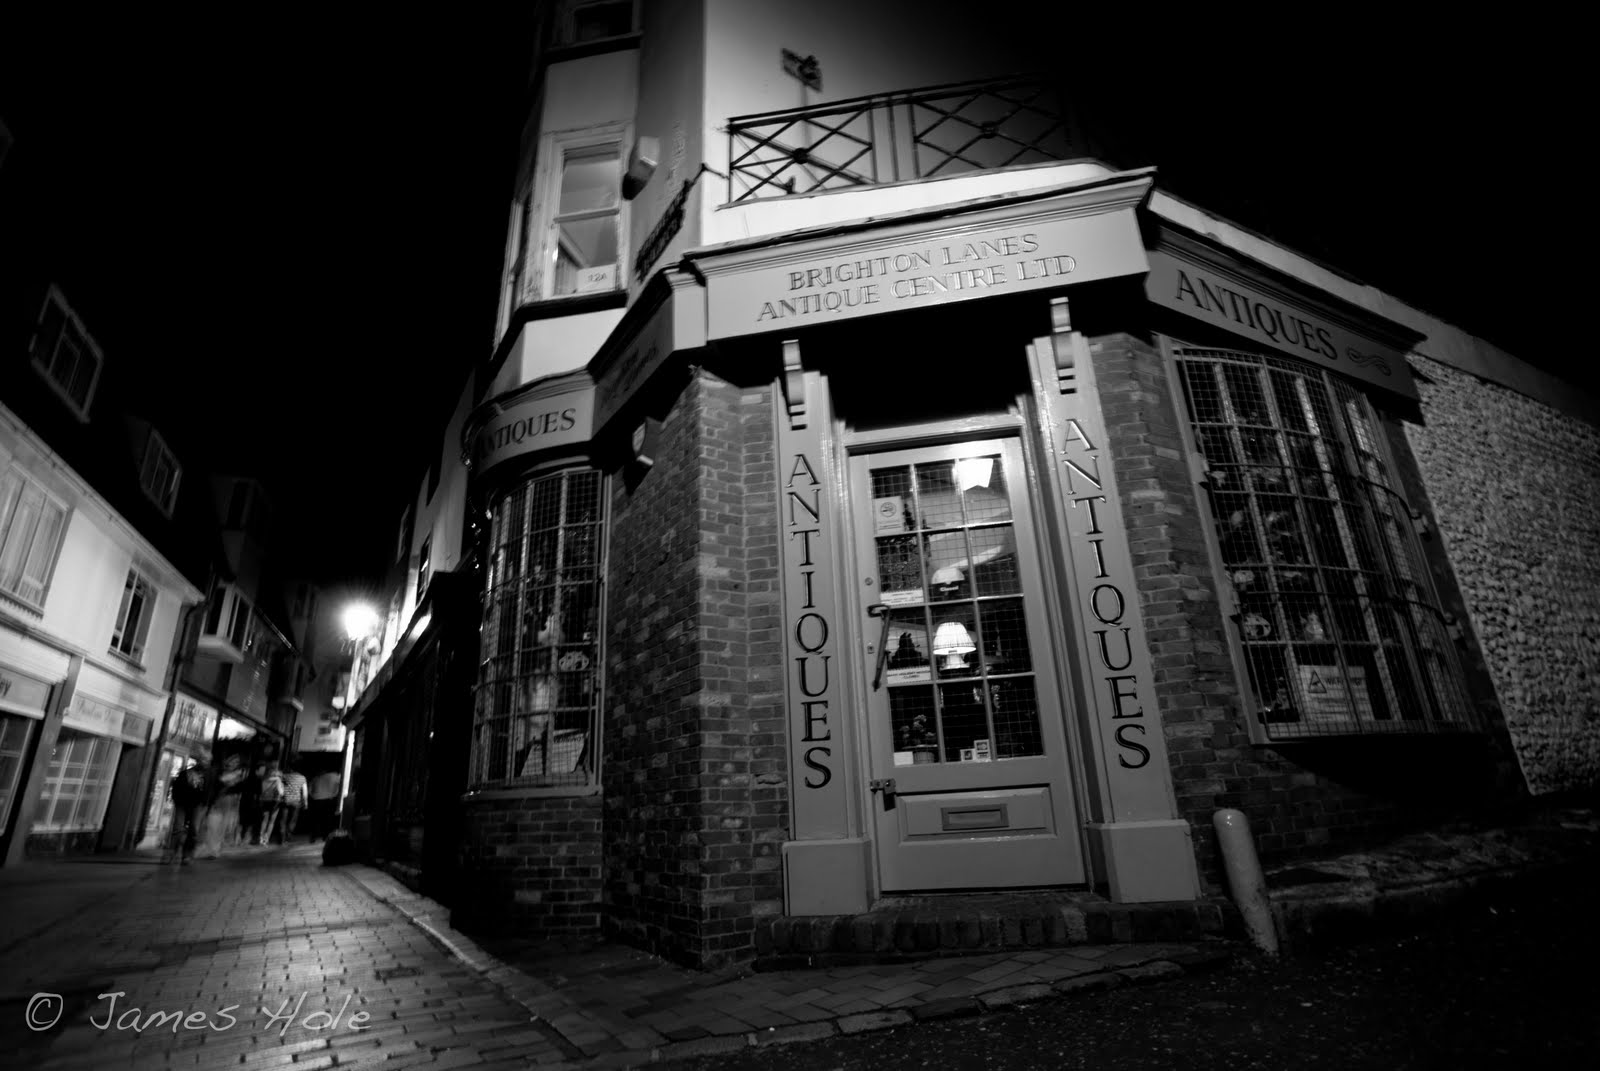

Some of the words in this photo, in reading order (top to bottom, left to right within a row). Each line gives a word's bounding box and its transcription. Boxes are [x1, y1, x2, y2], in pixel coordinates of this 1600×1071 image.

[756, 283, 881, 322] ANTIQUE
[889, 264, 1008, 299] CENTRE
[1016, 254, 1077, 281] LTD
[788, 250, 933, 291] BRIGHTON
[942, 233, 1040, 265] LANES
[1176, 269, 1338, 360] ANTIQUES
[786, 454, 832, 789] ANTIQUES
[1060, 418, 1151, 769] ANTIQUES
